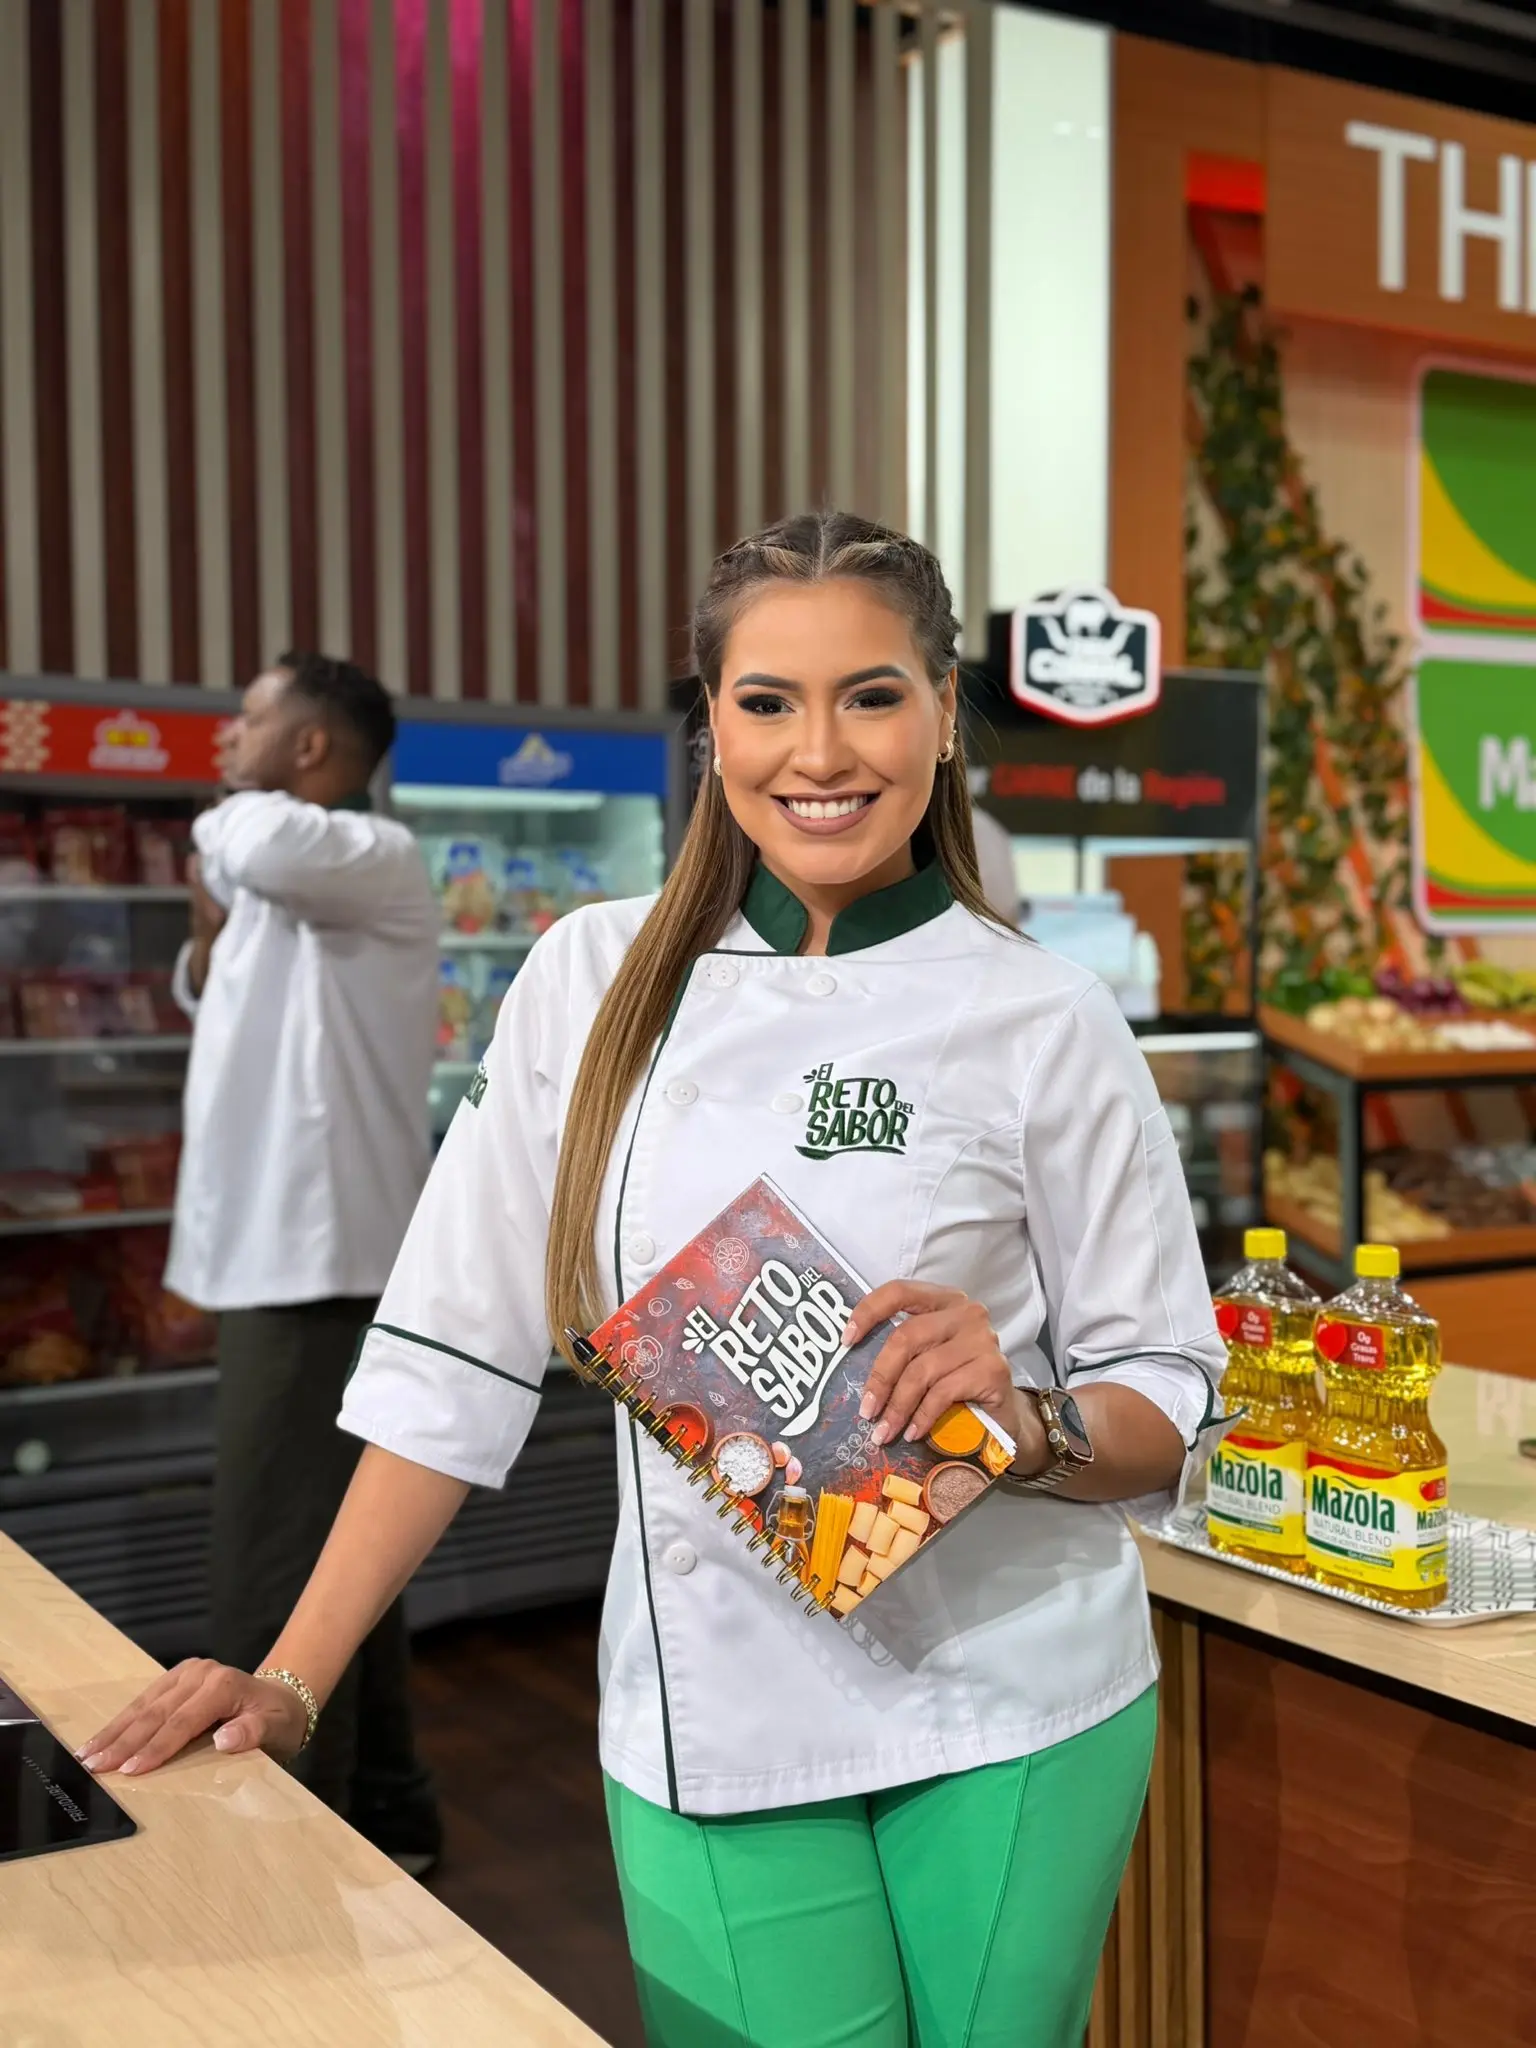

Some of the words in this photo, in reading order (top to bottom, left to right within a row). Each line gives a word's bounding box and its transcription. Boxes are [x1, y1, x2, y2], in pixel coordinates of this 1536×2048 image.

[1344, 119, 1536, 316] TH
[808, 1077, 897, 1112] RETO
[894, 1100, 916, 1115] DEL
[806, 1109, 909, 1147] SABOR
[709, 1259, 802, 1386] RETO
[798, 1266, 823, 1289] DEL
[751, 1280, 854, 1419] SABOR
[1211, 1452, 1283, 1501] Mazola
[1312, 1474, 1394, 1533] Mazola
[1313, 1516, 1352, 1539] NATURAL
[1355, 1530, 1392, 1548] BLEND
[49, 1783, 88, 1823] FRIGIDAIRE
